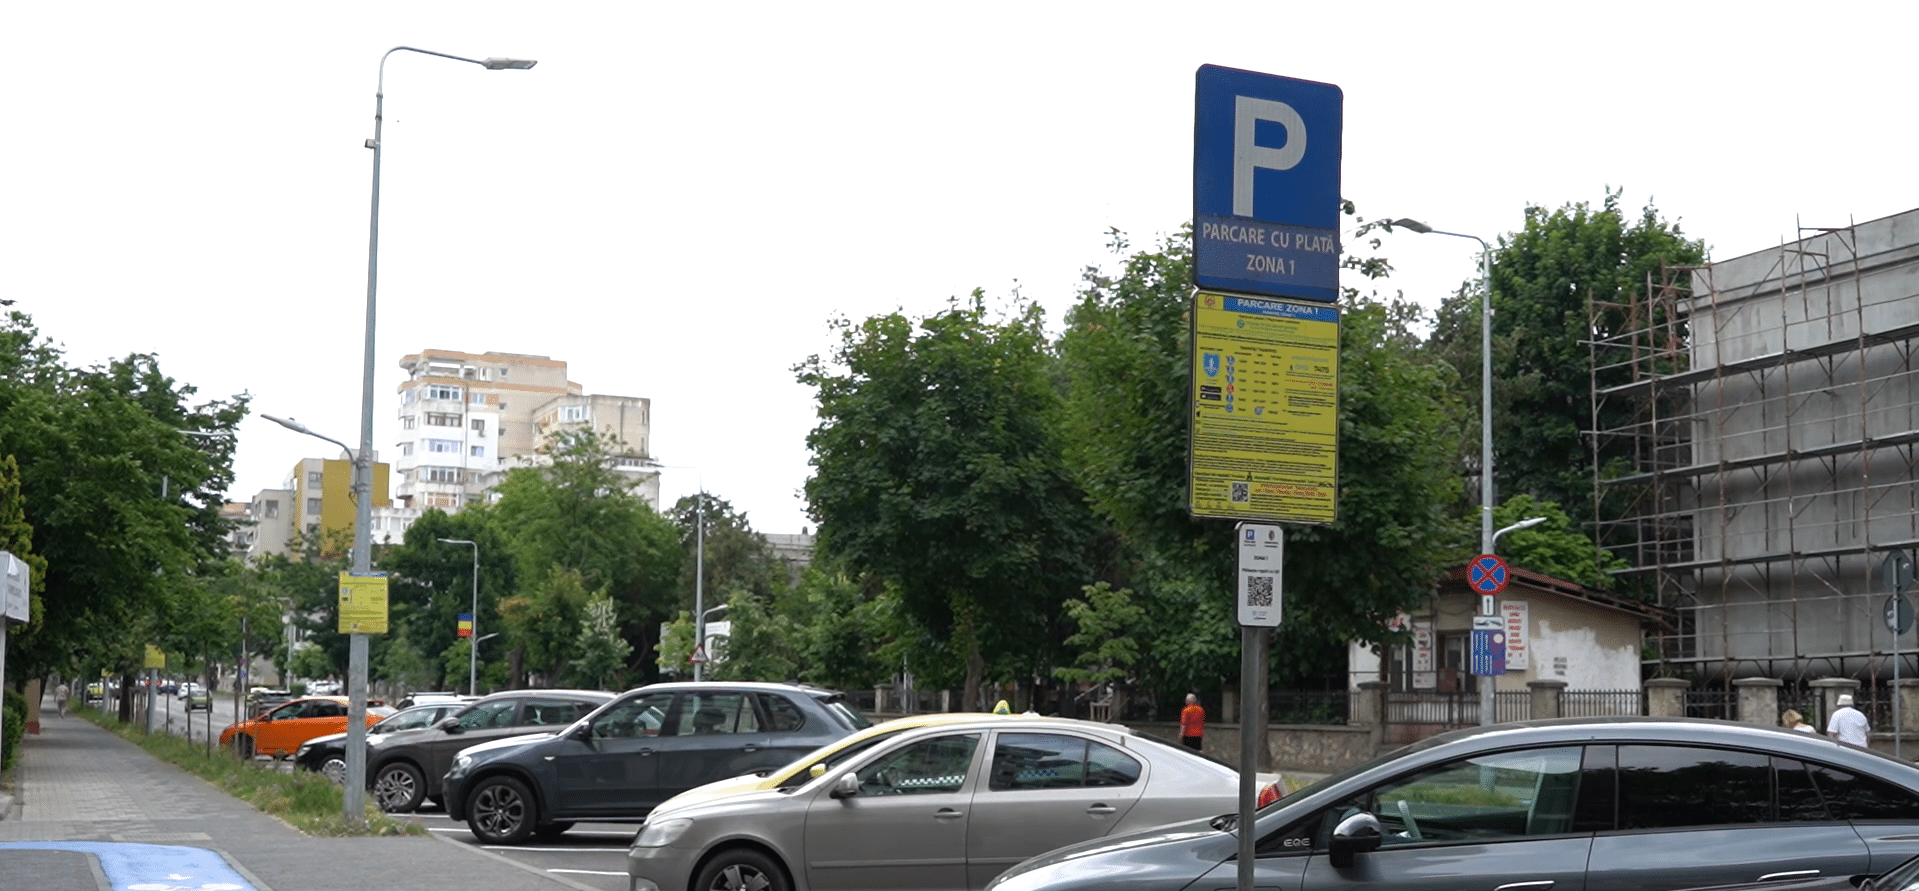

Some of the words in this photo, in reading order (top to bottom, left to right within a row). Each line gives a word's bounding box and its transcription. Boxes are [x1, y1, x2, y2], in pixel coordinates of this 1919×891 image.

[1233, 95, 1307, 217] P
[1203, 222, 1265, 245] PARCARE
[1271, 231, 1289, 248] CU
[1296, 234, 1334, 254] PLATĂ
[1246, 254, 1285, 274] ZONA
[1289, 260, 1295, 275] 1
[1237, 299, 1284, 311] PARCARE
[1286, 304, 1313, 315] ZONA
[1314, 307, 1319, 315] 1
[1283, 837, 1310, 847] EQE
